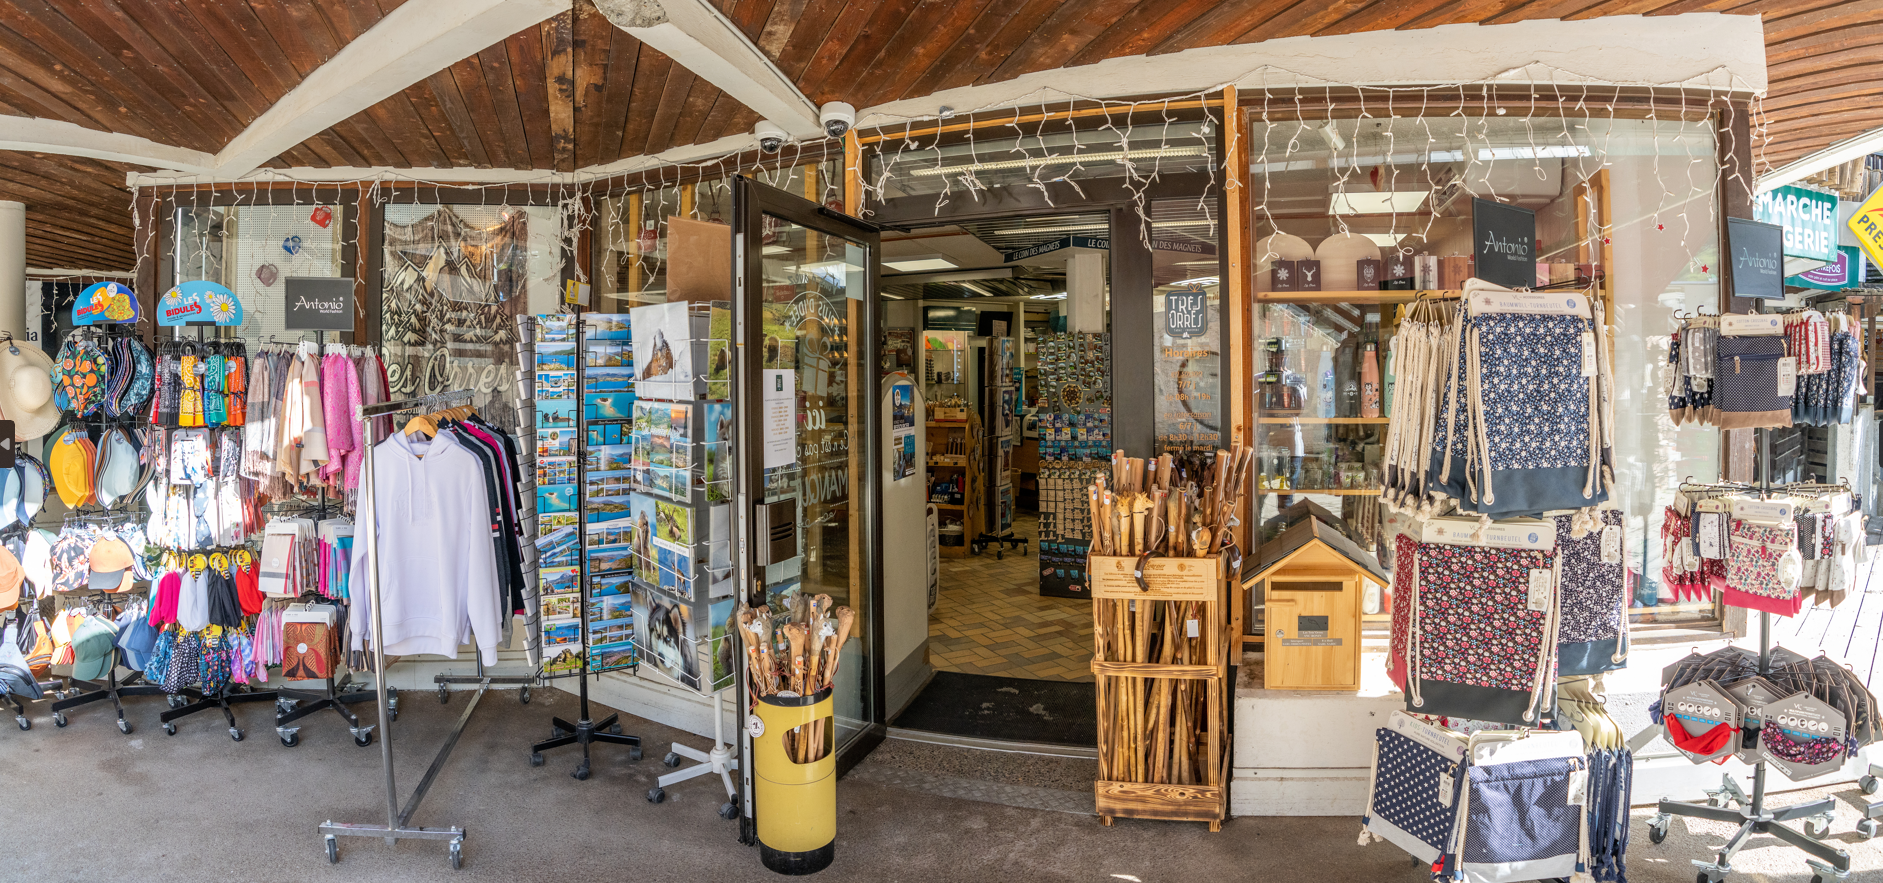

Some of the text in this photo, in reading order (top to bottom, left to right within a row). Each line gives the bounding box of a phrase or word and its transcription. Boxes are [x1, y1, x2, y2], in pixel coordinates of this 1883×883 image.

[1753, 190, 1832, 225] MARCHE
[1087, 238, 1097, 248] LE
[1159, 242, 1171, 250] DES
[1172, 243, 1202, 253] MAGNETS
[1483, 230, 1528, 255] Antonio
[1013, 240, 1061, 260] LE COIN DES MAGNETS
[1739, 247, 1777, 269] Antonio
[90, 292, 103, 304] LES
[183, 292, 200, 305] LES
[293, 295, 344, 311] Antonio
[1165, 347, 1209, 358] Horaires
[424, 346, 513, 395] Orres
[1178, 381, 1191, 390] 7/7
[1175, 393, 1189, 401] 08h
[1197, 393, 1211, 401] 19h
[1179, 422, 1193, 431] 6/7
[1169, 433, 1188, 442] 8h30
[1195, 433, 1219, 441] 12h30
[1409, 720, 1450, 747] KIDS-TURNBEUTEL
